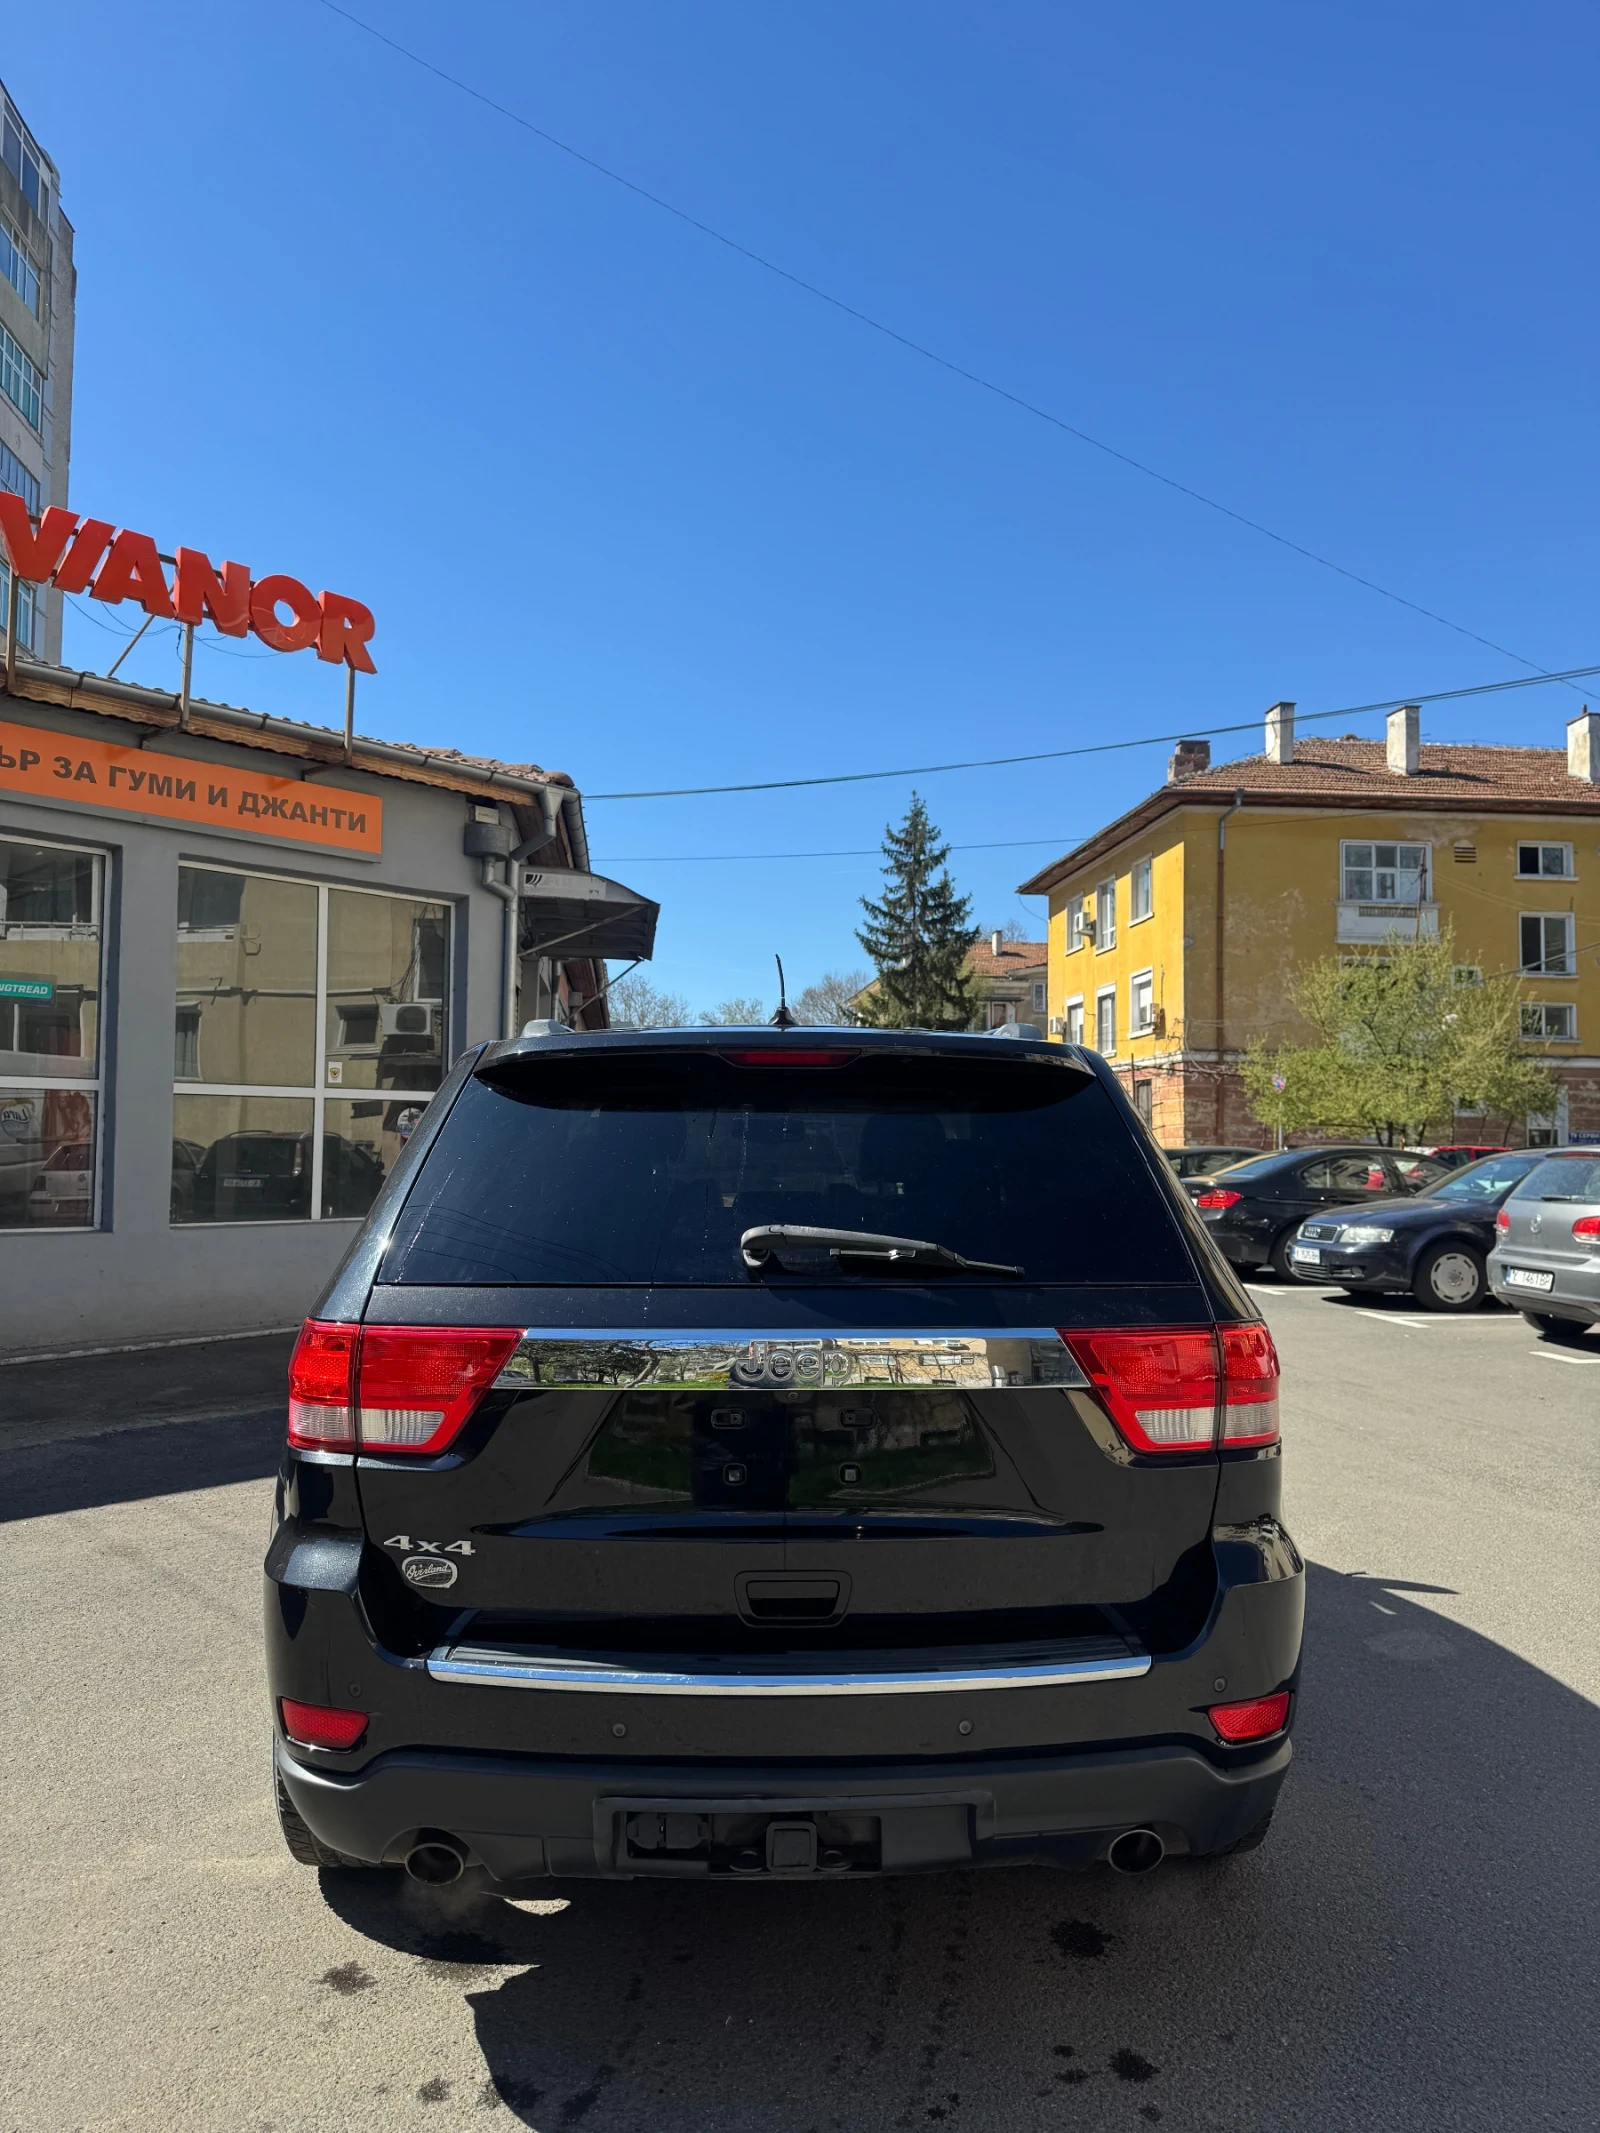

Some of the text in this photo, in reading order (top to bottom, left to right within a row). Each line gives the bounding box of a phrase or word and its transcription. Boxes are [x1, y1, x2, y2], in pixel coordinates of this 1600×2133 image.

[0, 491, 378, 675] VIANOR
[53, 756, 97, 784] ЗА
[109, 765, 196, 802] ГУМИ
[208, 784, 228, 808] И
[238, 790, 366, 833] ДЖАНТИ
[735, 1340, 851, 1388] Jeep
[383, 1535, 477, 1556] 4x4
[406, 1563, 452, 1580] Overland
